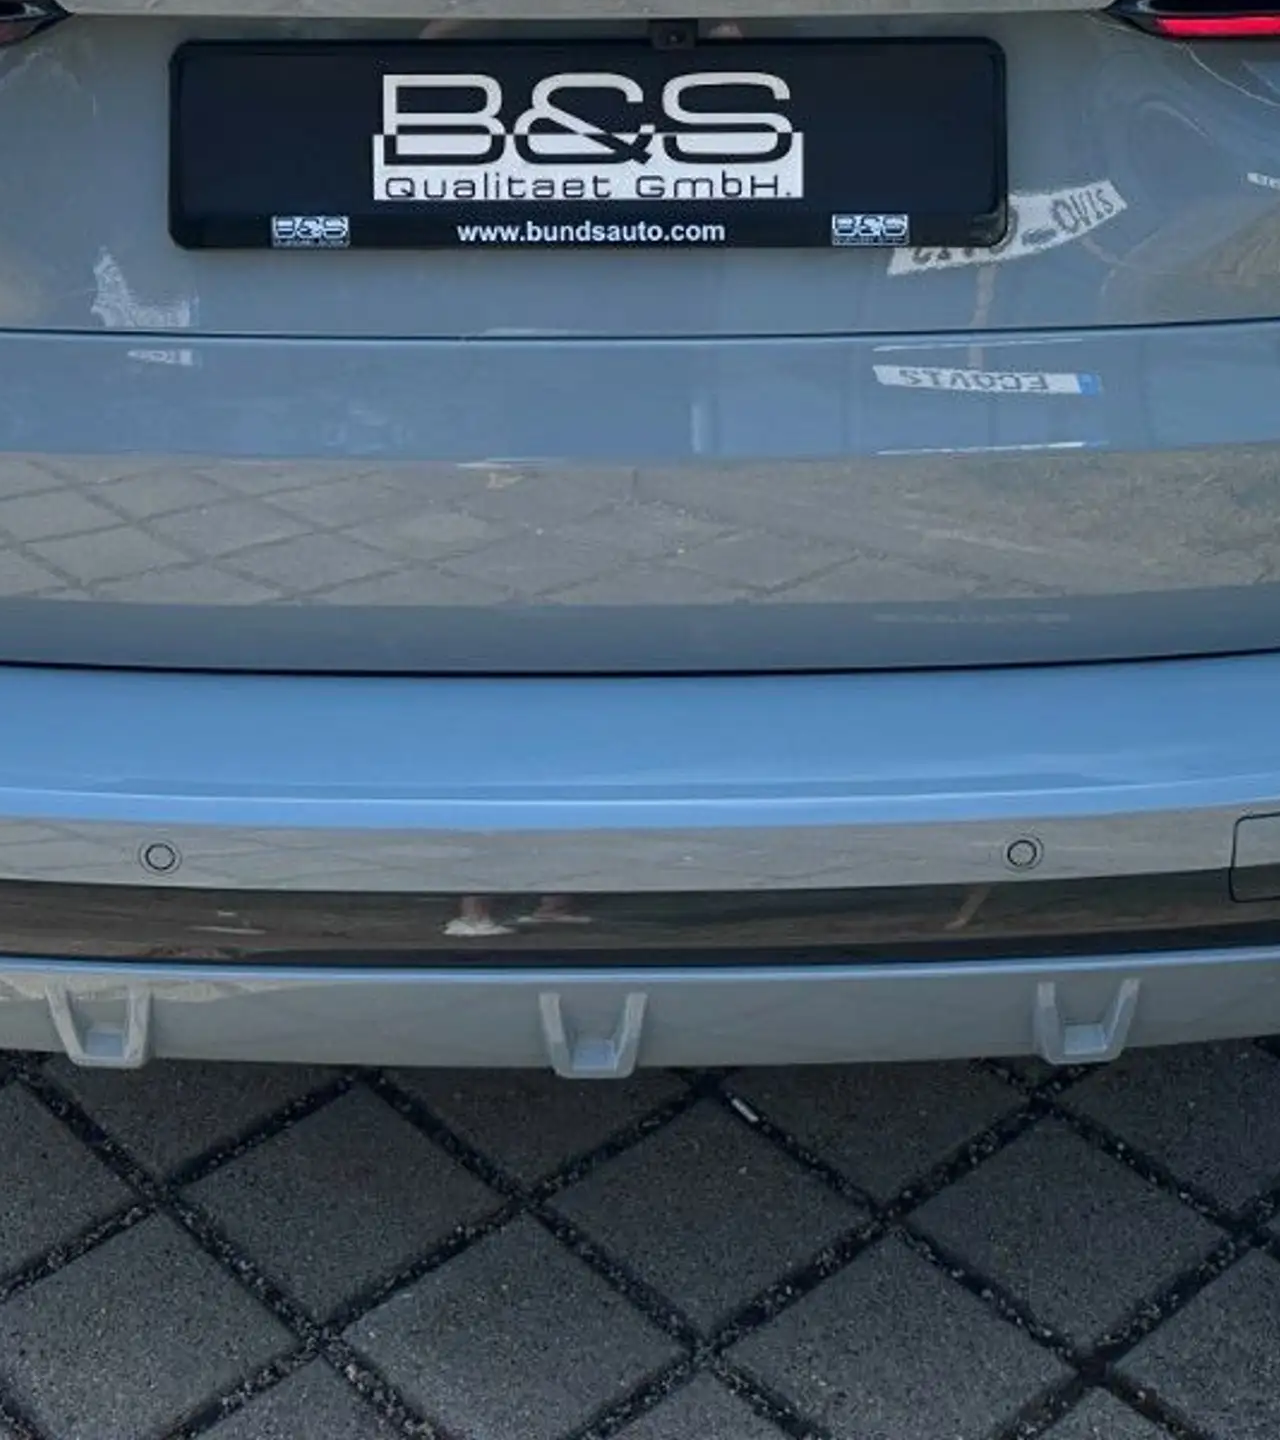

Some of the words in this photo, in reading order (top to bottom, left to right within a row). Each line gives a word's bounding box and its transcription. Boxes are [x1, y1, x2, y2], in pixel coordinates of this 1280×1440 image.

[382, 71, 793, 166] B&S
[385, 171, 612, 199] Qualitaet
[635, 170, 793, 198] GmbH.
[456, 220, 727, 243] www.bundsauto.com
